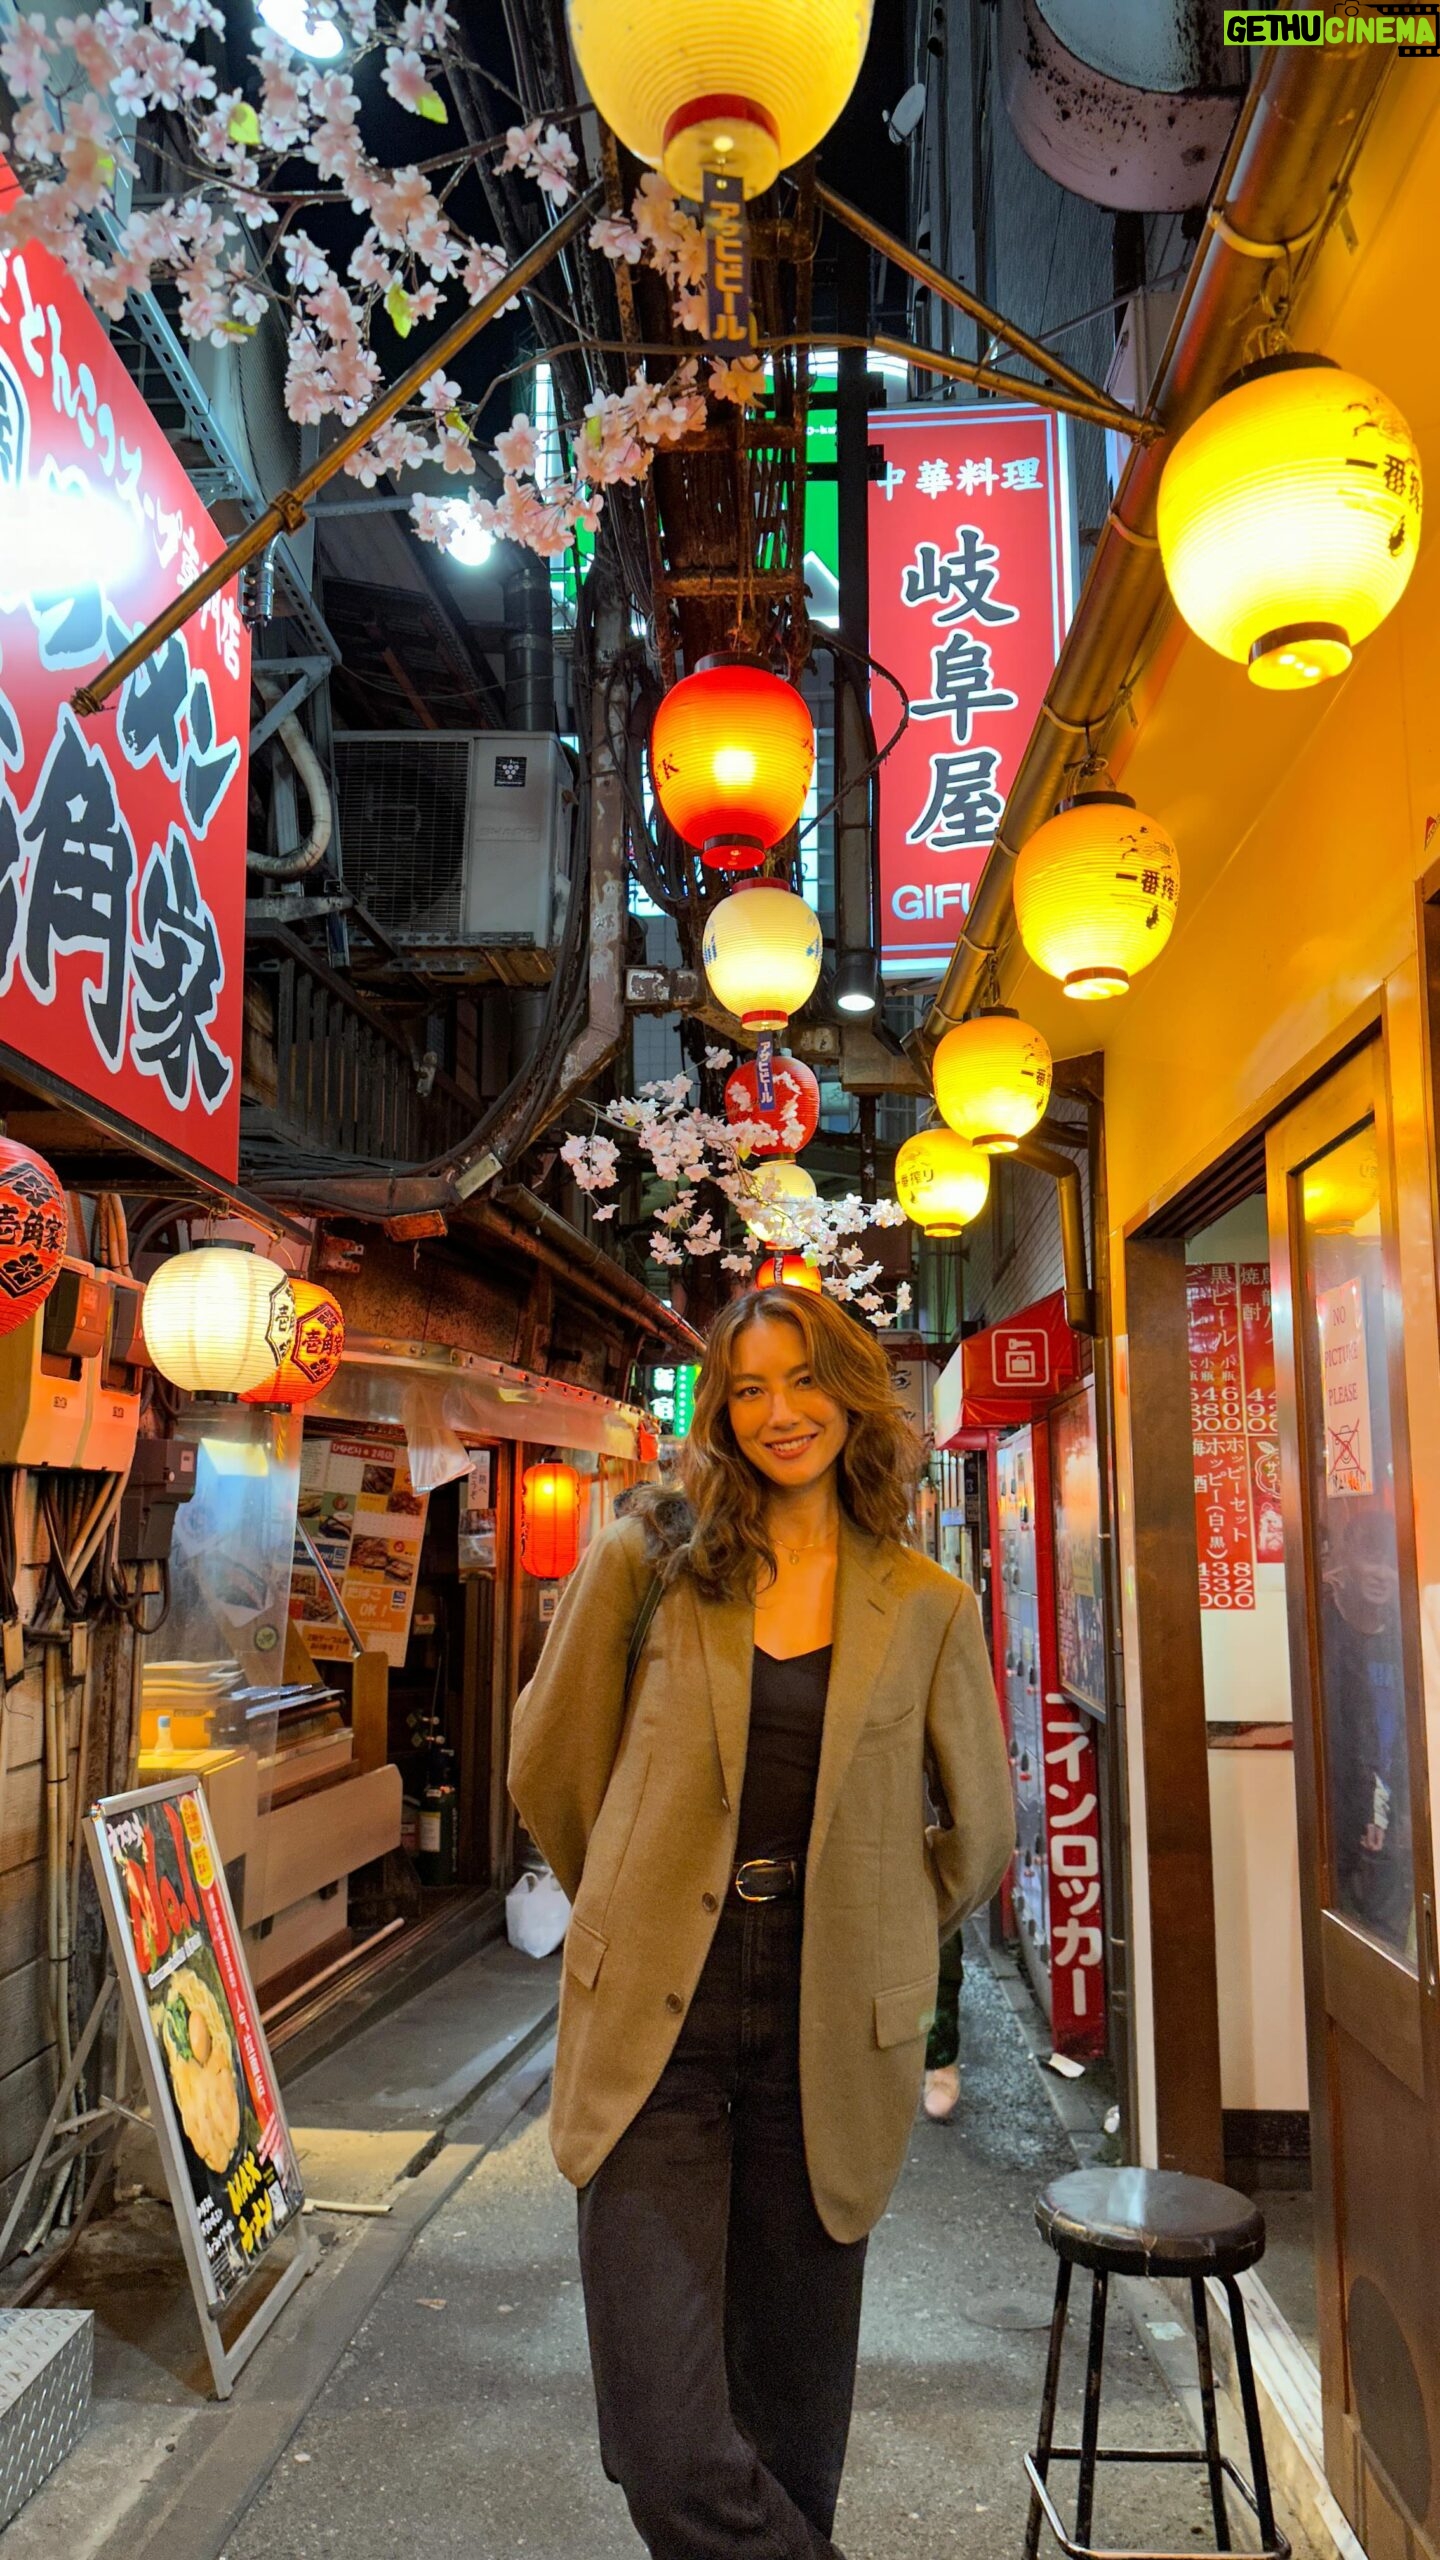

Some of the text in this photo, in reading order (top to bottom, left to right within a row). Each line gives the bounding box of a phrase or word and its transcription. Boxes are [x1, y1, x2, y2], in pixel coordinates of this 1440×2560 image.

[877, 457, 1044, 501] 中華料理
[902, 526, 1017, 850] 岐阜屋
[0, 700, 234, 1114] 角家
[1332, 1306, 1347, 1327] NO
[1328, 1383, 1358, 1406] PLEASE
[1226, 1437, 1248, 1543] ホッピーセット
[227, 2151, 263, 2216] MAX
